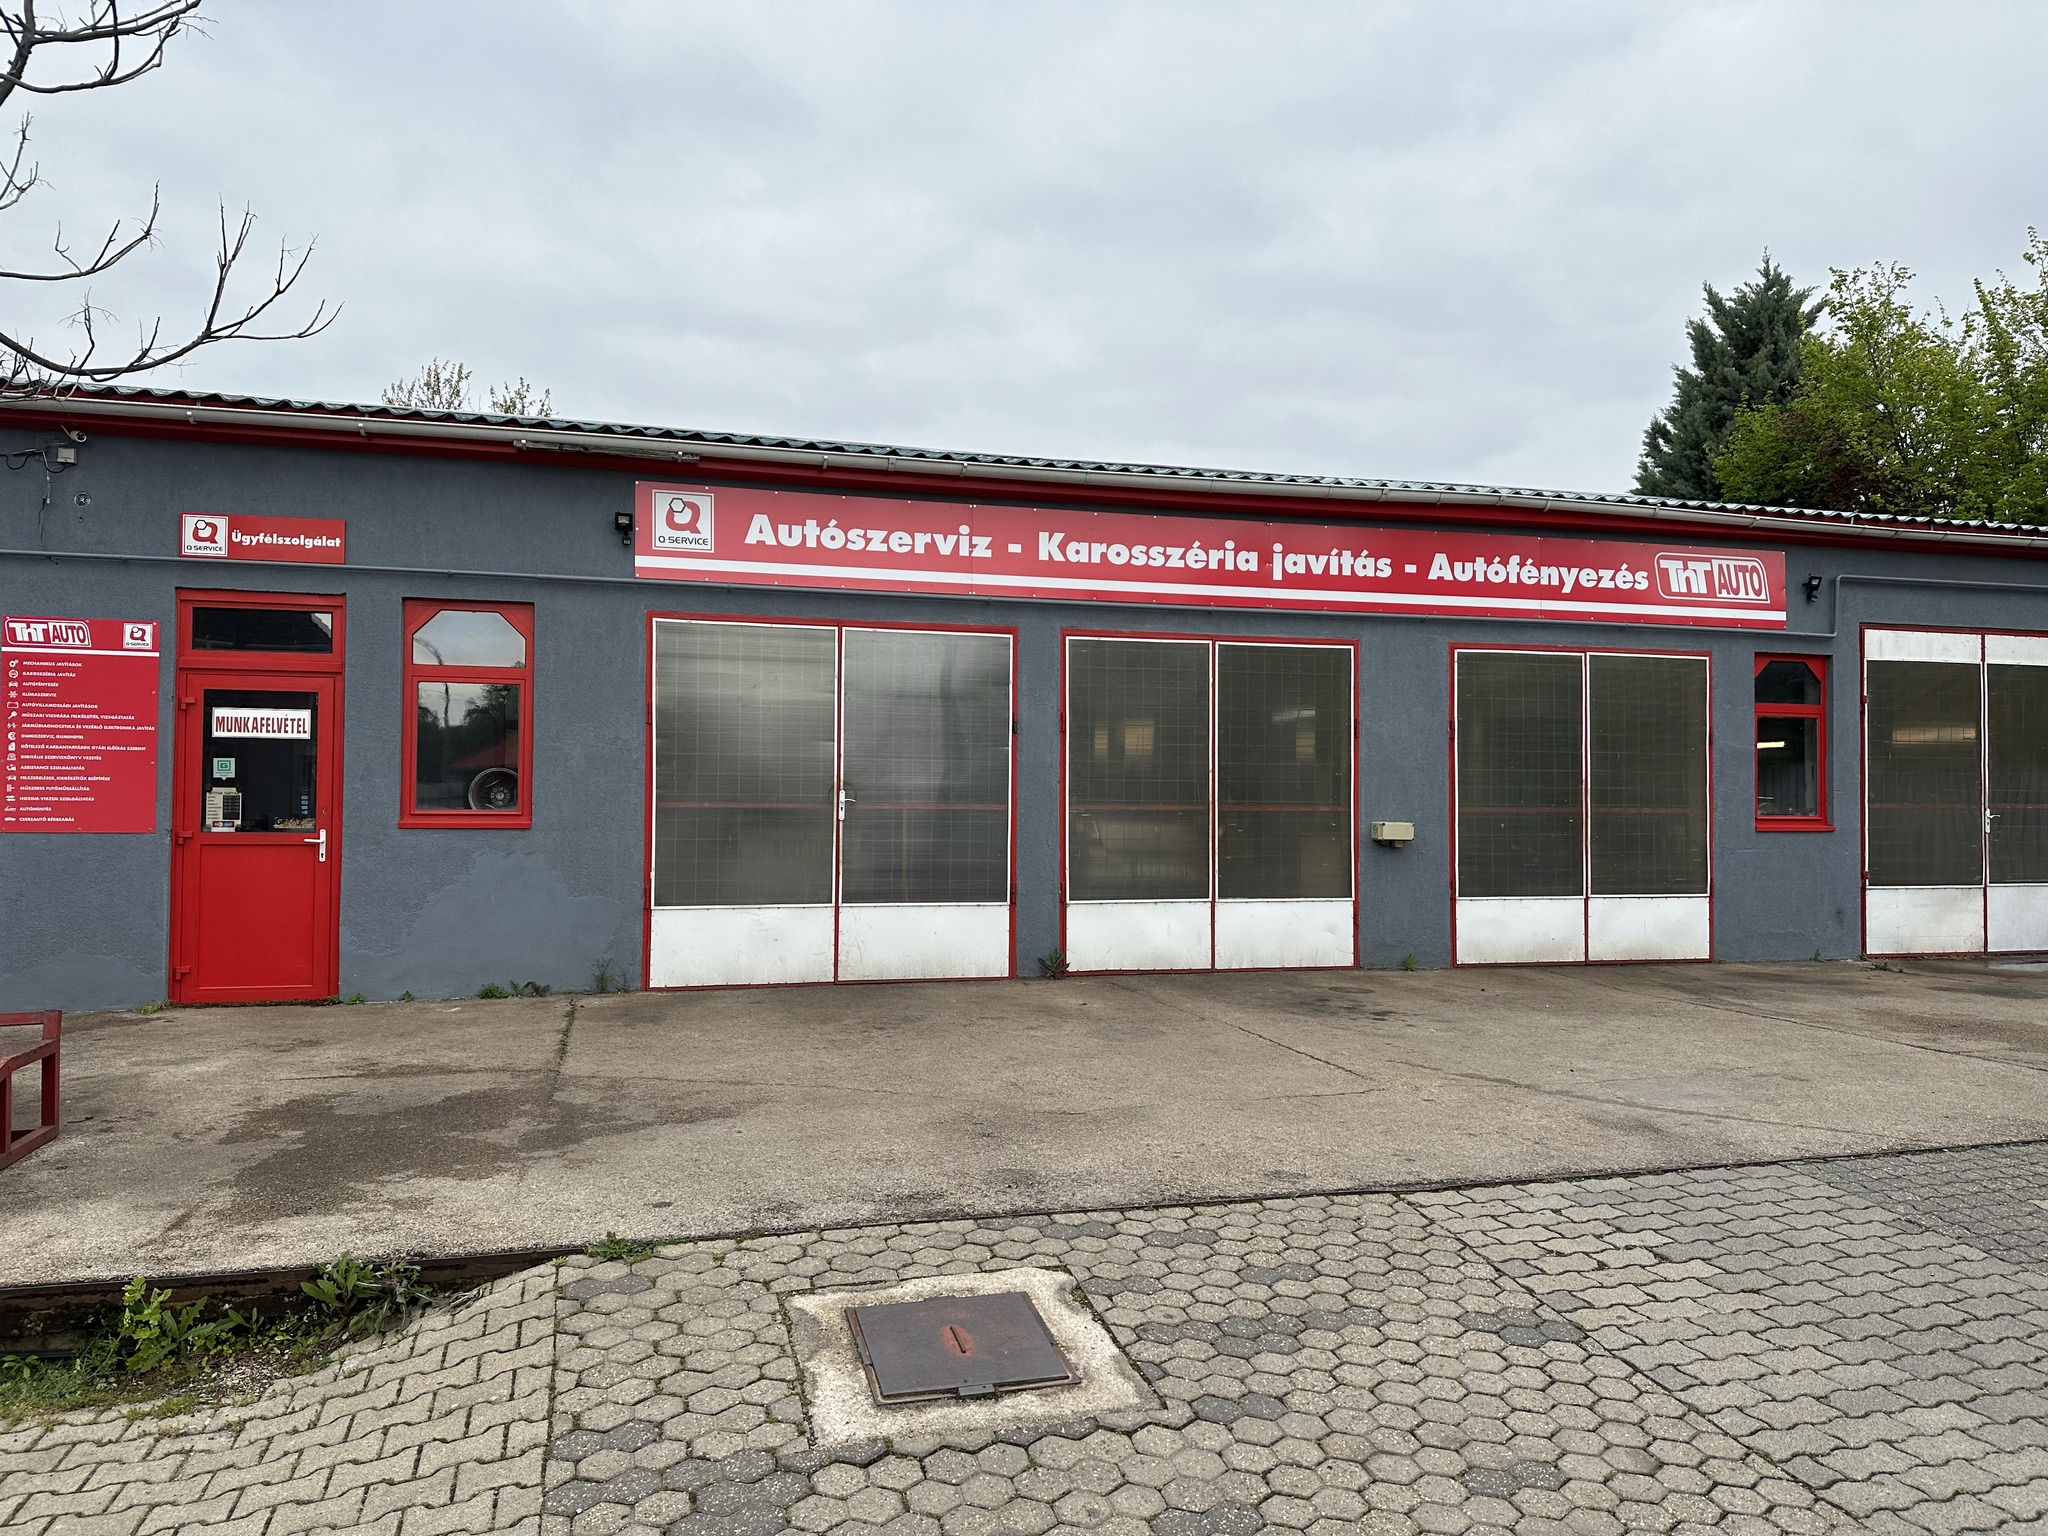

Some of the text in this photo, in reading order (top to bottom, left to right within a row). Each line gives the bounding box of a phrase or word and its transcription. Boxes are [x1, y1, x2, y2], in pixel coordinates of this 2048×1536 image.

[231, 530, 341, 548] Ügyfélszolgálat
[744, 513, 993, 557] Autószerviz
[1038, 531, 1259, 572] Karosszéria
[1272, 540, 1393, 581] javítás
[1427, 552, 1649, 594] Autófényezés
[1714, 561, 1767, 598] AUTO
[51, 623, 87, 644] AUTO
[215, 714, 308, 734] MUNKAFELVÉTEL
